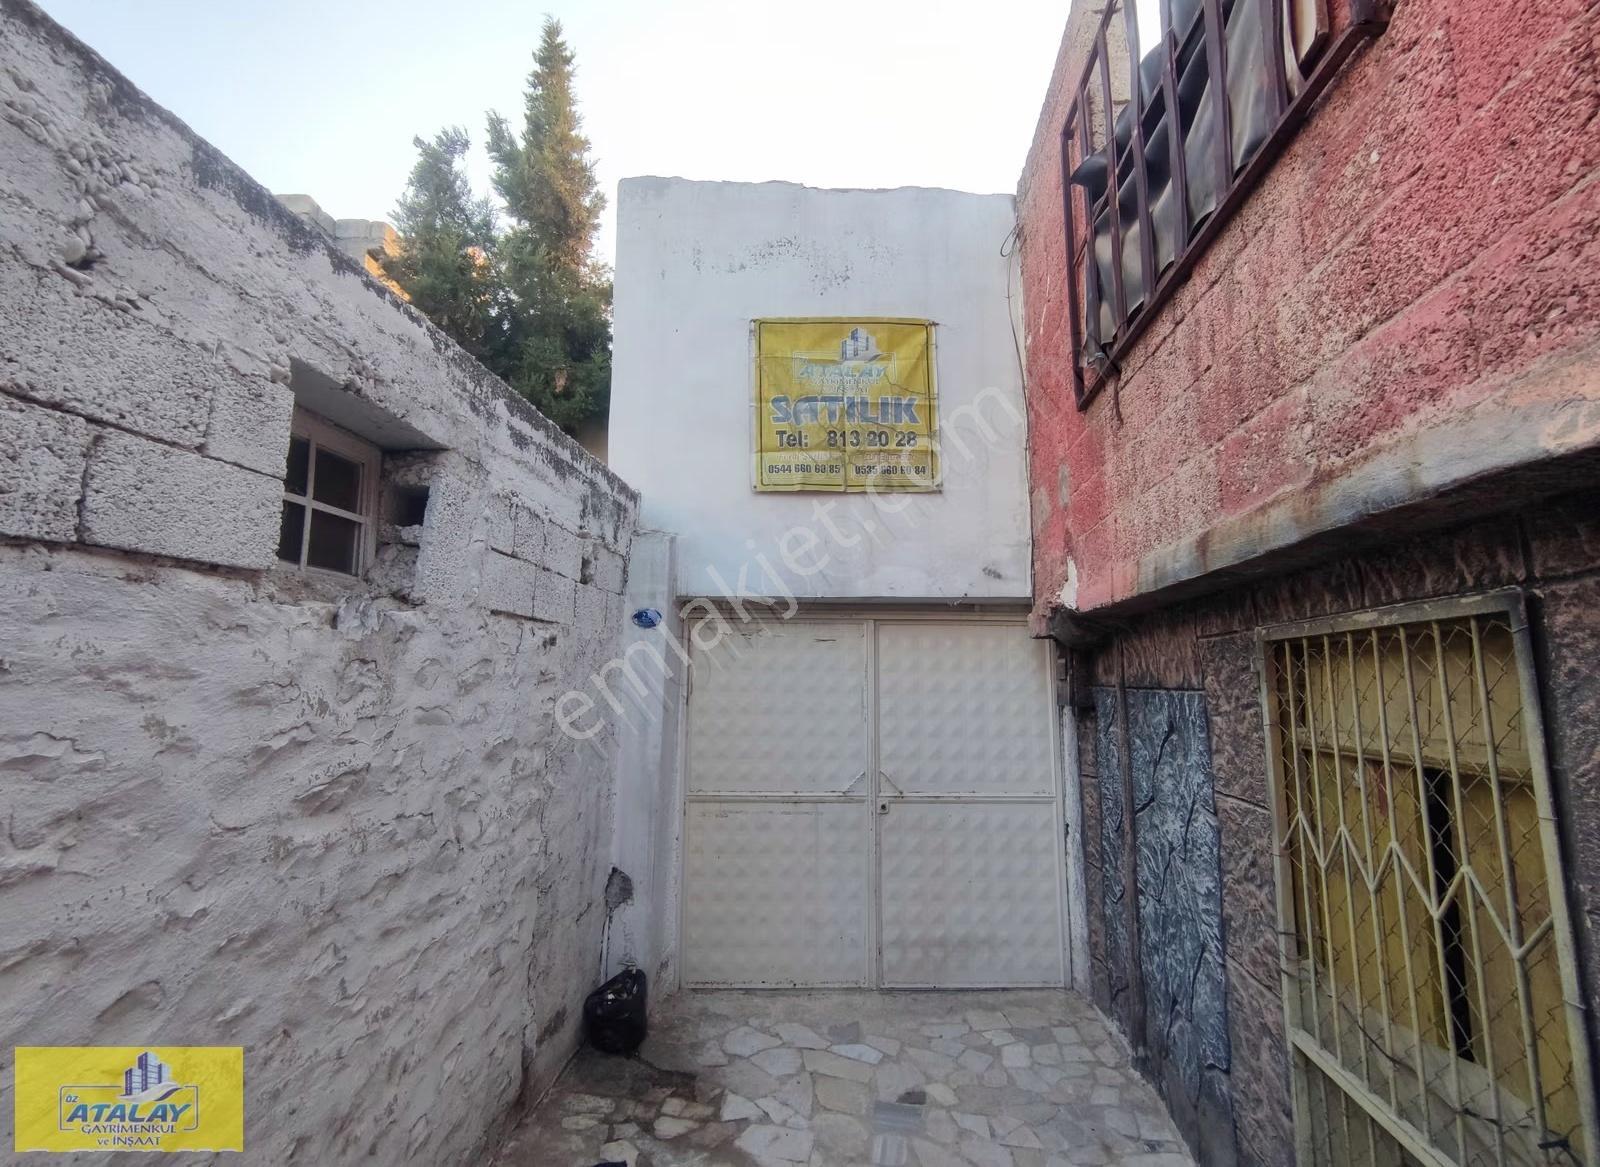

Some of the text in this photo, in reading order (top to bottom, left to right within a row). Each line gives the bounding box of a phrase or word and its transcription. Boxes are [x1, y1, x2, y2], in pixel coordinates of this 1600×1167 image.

[770, 395, 920, 425] SATILIK
[776, 430, 917, 448] Tel: 813 20 28
[768, 464, 792, 474] 0544
[794, 463, 812, 473] 660
[829, 464, 841, 474] 85
[855, 465, 878, 475] 0535
[914, 465, 926, 475] 84
